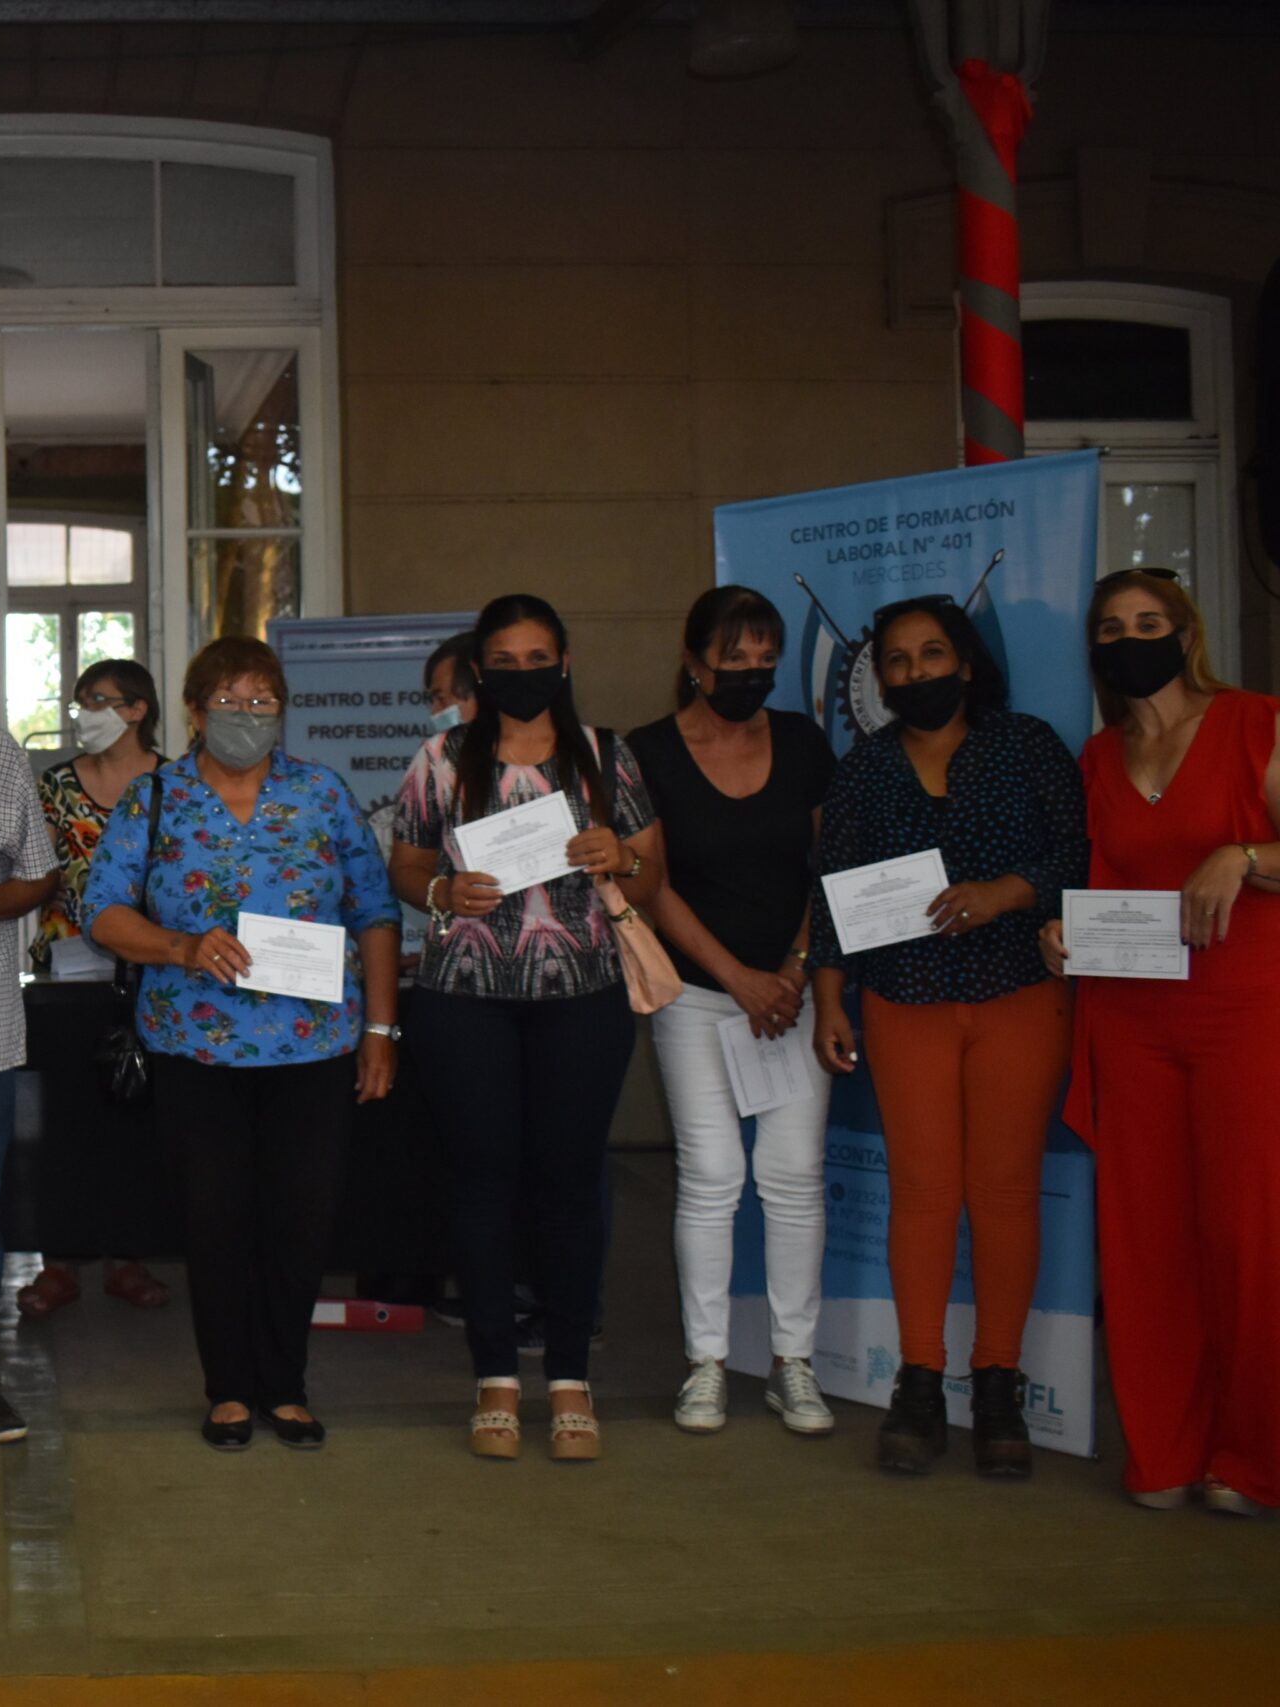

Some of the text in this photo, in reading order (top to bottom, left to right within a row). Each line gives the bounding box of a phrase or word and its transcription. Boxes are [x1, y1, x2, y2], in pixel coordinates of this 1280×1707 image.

[790, 498, 1015, 544] CENTRO DE FORMACIÓN
[826, 540, 908, 564] LABORAL
[941, 532, 973, 550] 401
[852, 560, 947, 586] MERCEDES
[292, 692, 364, 708] CENTRO
[369, 692, 393, 706] DE
[308, 724, 433, 740] PROFESIONAL
